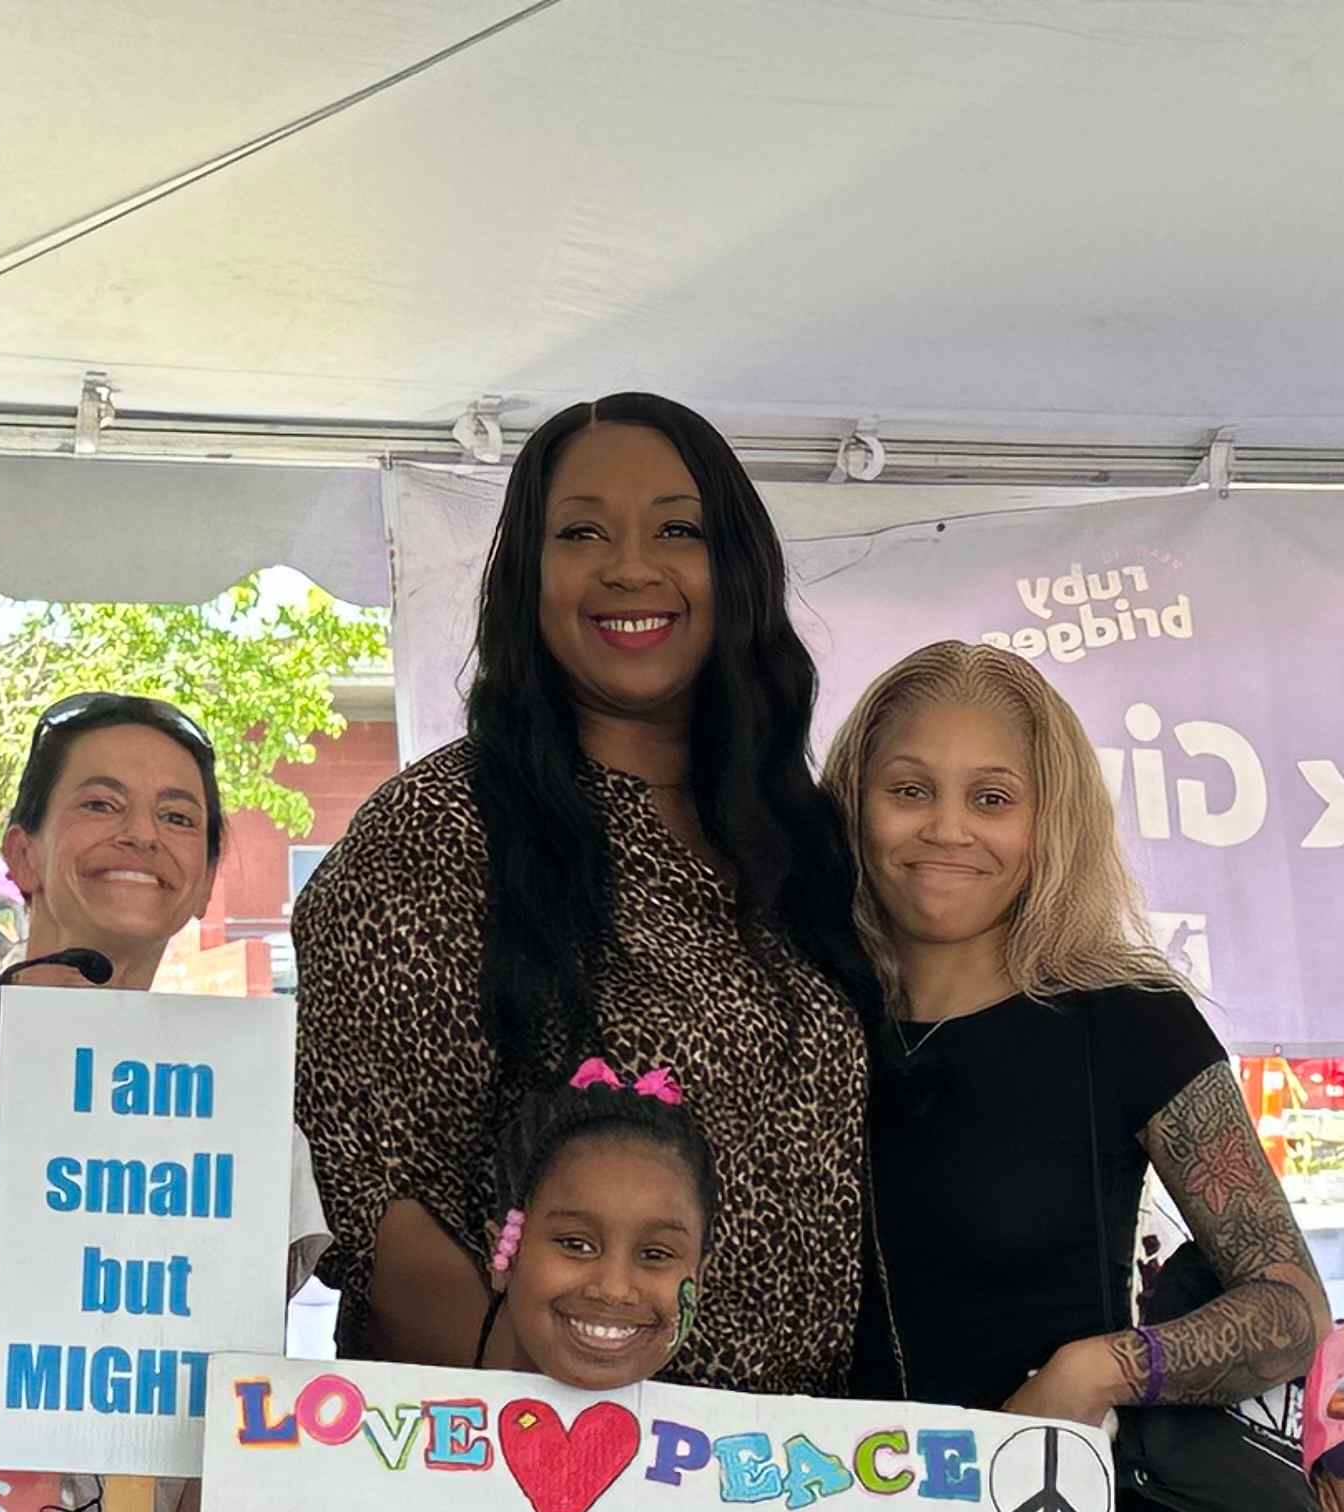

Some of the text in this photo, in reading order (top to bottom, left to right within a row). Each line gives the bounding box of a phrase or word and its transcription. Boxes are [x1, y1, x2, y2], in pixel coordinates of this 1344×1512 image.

[73, 1047, 213, 1118] I am
[46, 1153, 234, 1218] small
[81, 1246, 192, 1317] but
[5, 1342, 209, 1418] MIGHT
[234, 1374, 983, 1509] LOVE PEACE
